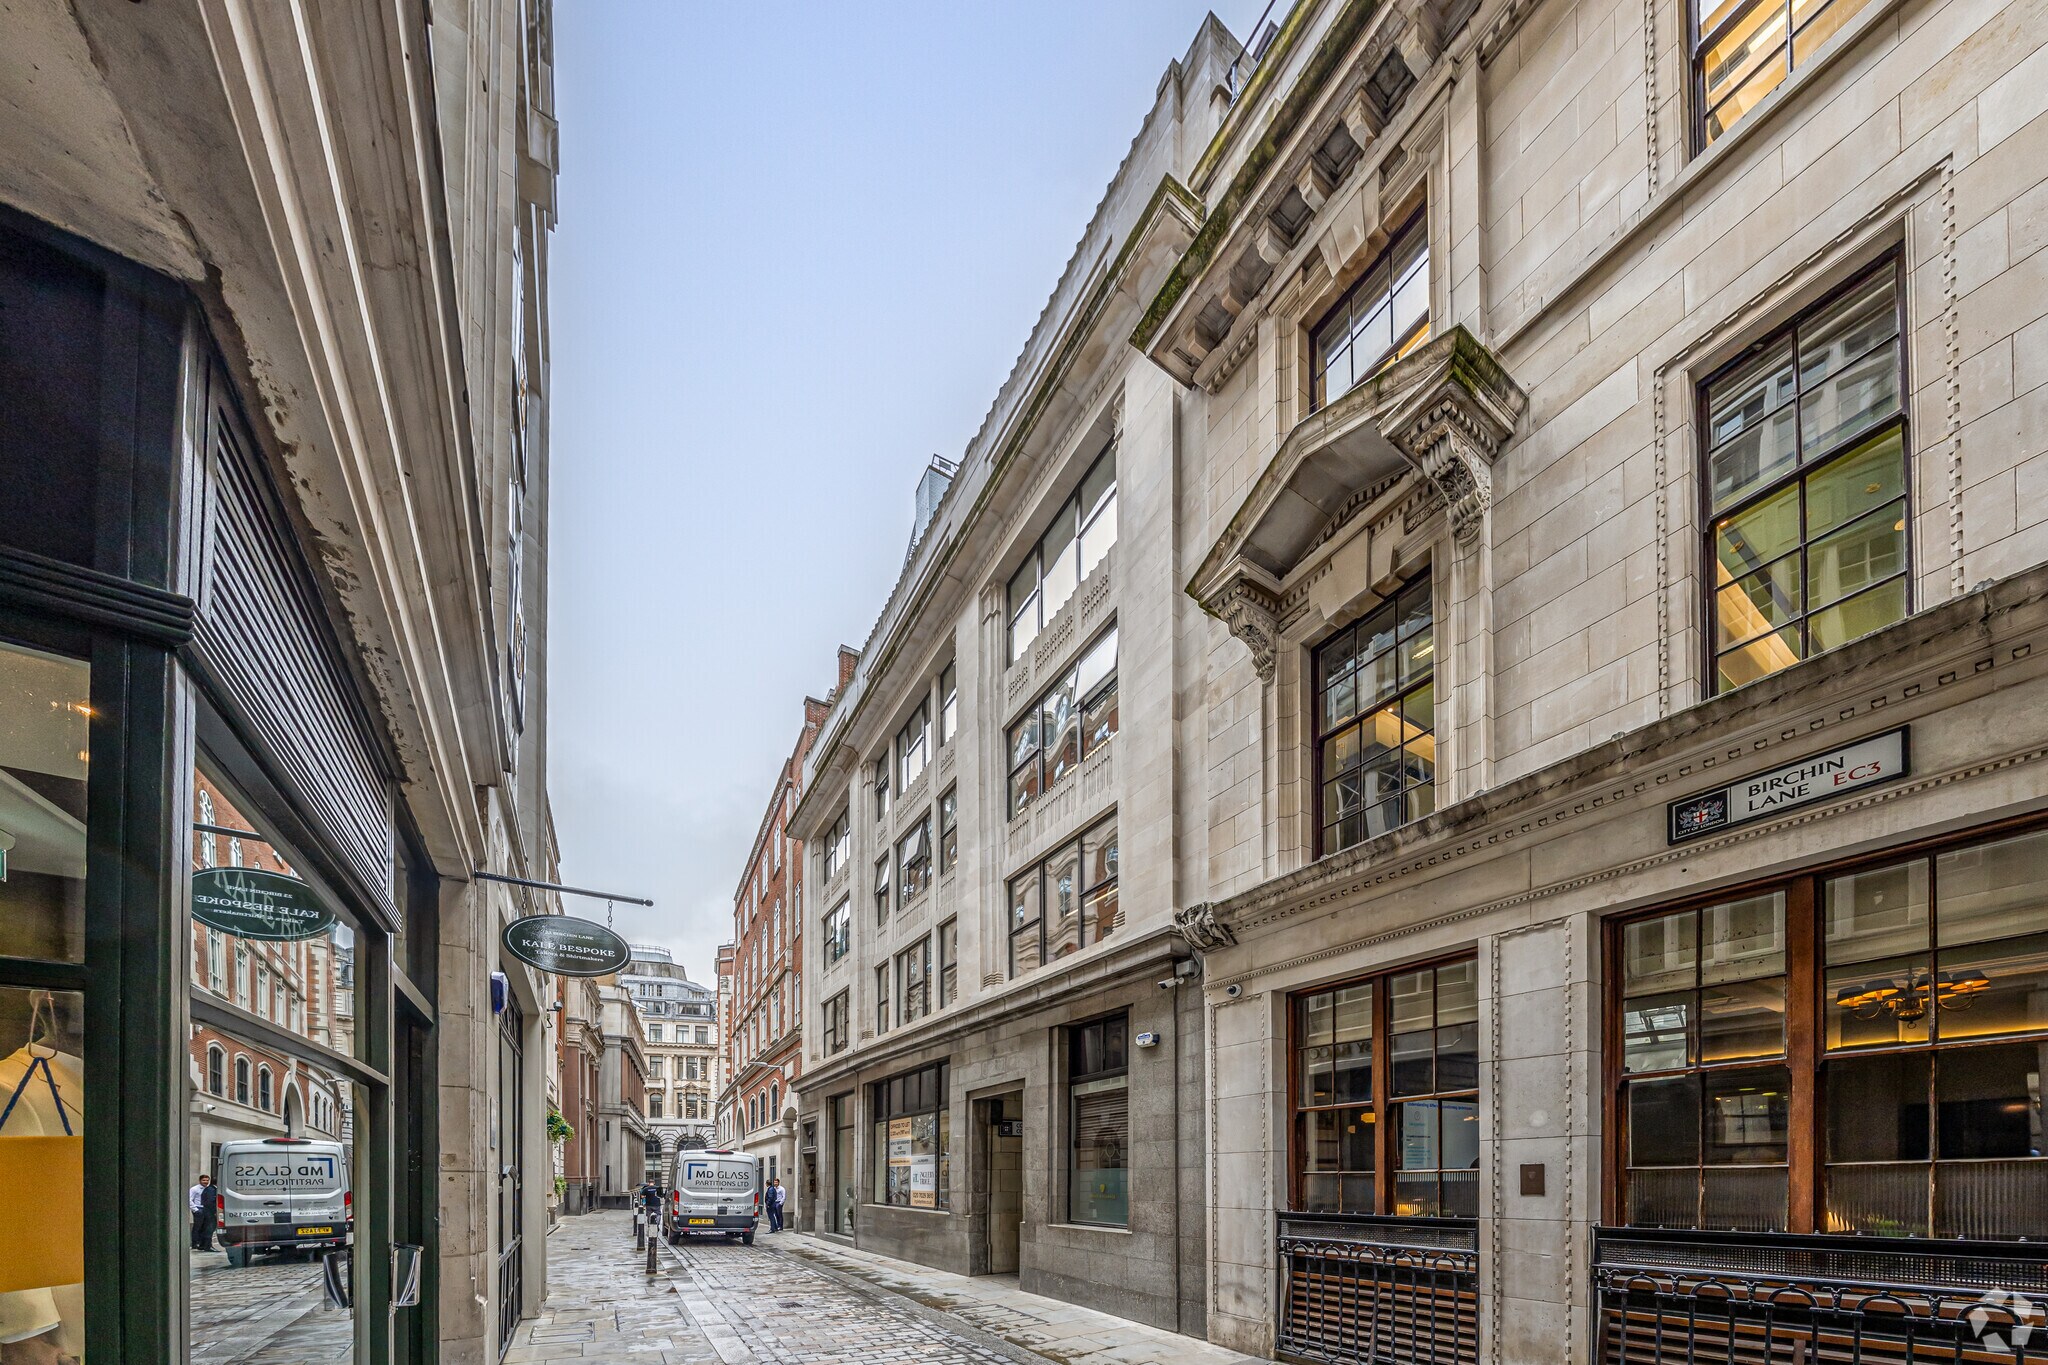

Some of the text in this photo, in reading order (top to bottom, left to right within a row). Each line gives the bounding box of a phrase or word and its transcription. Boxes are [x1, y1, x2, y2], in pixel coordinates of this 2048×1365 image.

[1748, 756, 1844, 797] BIRCHIN
[1748, 760, 1882, 812] LANE EC3
[1700, 817, 1725, 829] LONDON
[522, 939, 616, 957] KALE BESPOKE
[696, 1171, 749, 1180] MD GLASS
